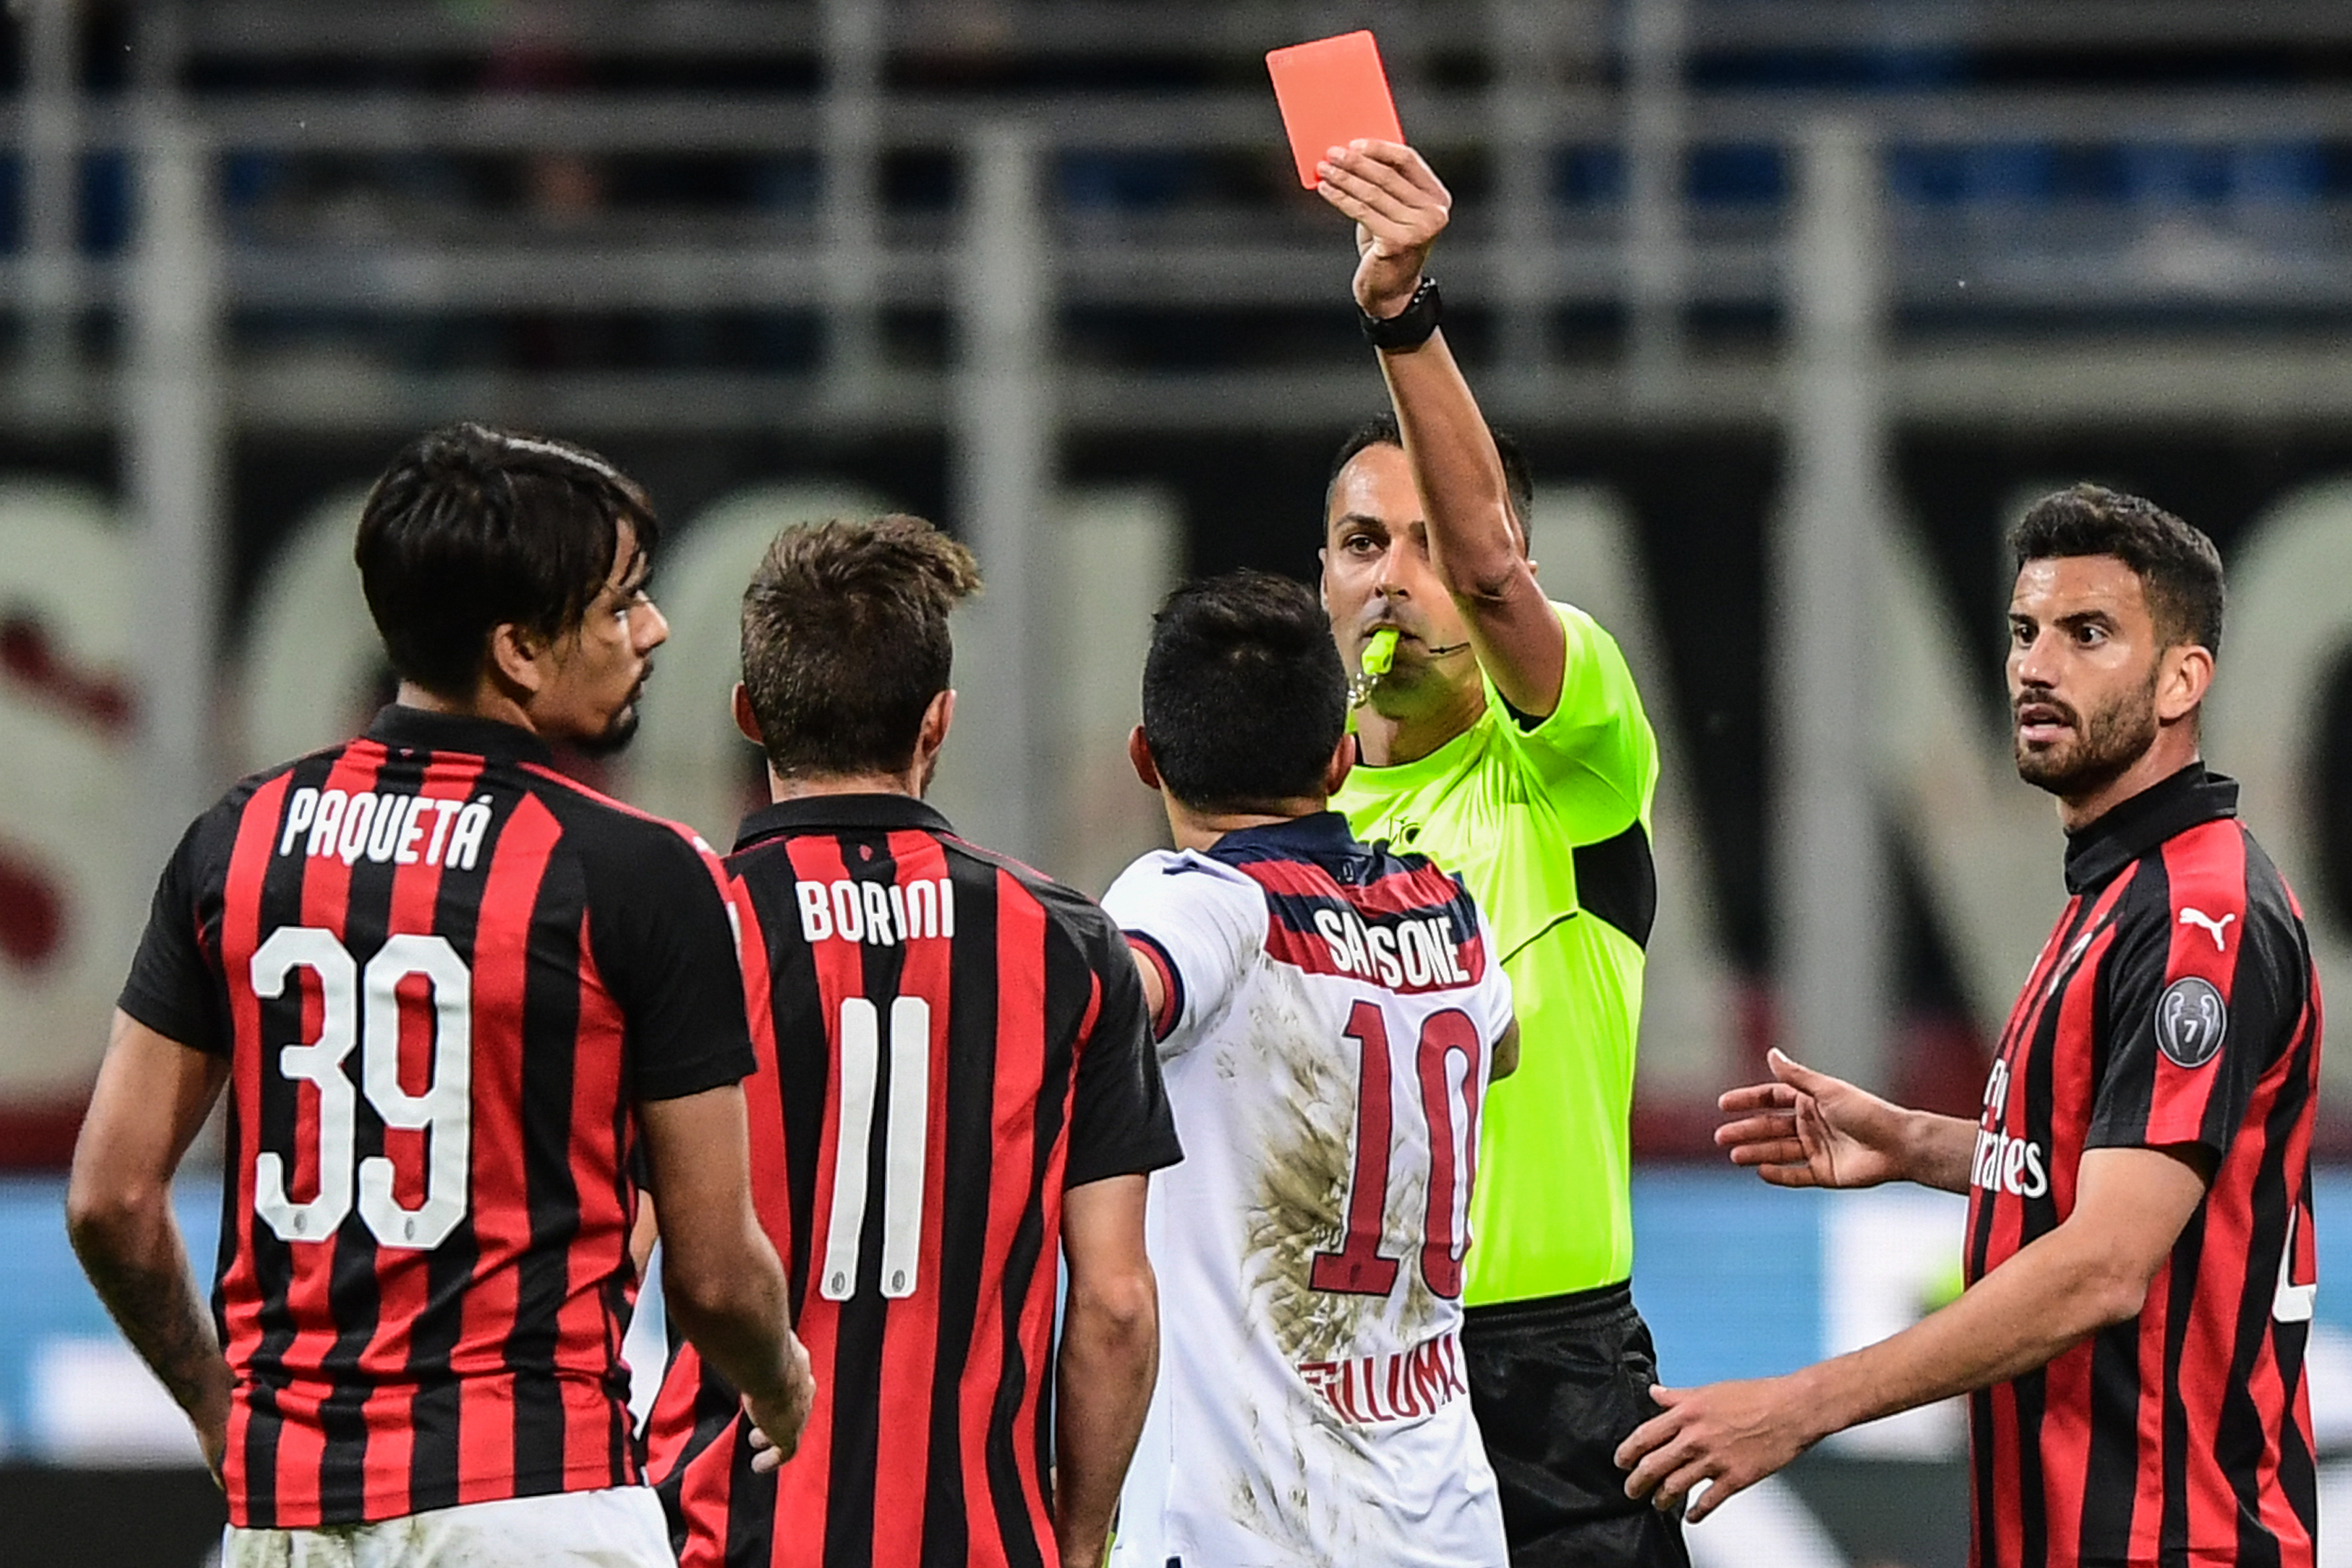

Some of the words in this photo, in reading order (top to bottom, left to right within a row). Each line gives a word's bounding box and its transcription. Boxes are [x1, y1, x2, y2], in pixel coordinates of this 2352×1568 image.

[279, 788, 493, 870] PAQUETÁ
[795, 879, 955, 945] BORINI
[1313, 908, 1471, 988] SASONE
[2183, 1019, 2198, 1043] 7
[250, 927, 472, 1250] 39
[820, 995, 930, 1301] 11
[1309, 998, 1481, 1299] 10
[1970, 1109, 2048, 1198] irates
